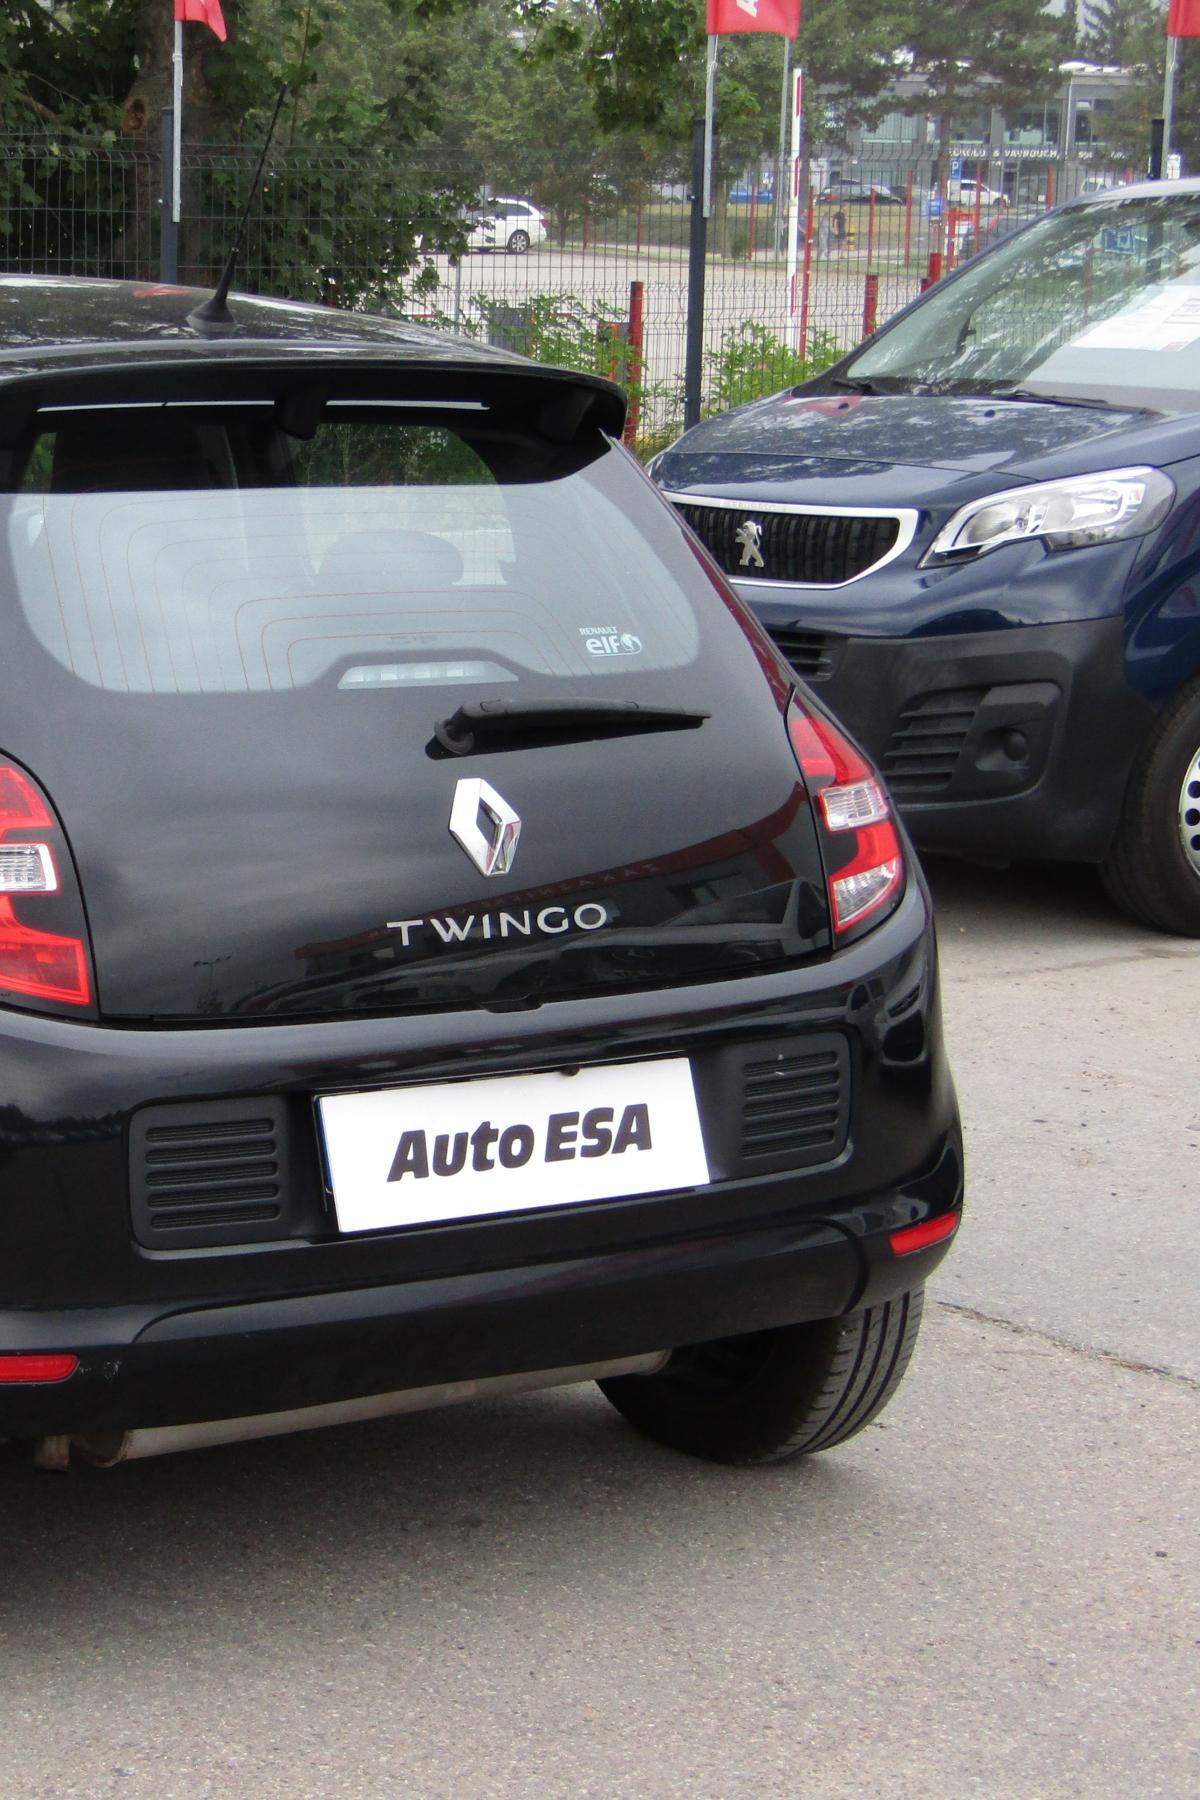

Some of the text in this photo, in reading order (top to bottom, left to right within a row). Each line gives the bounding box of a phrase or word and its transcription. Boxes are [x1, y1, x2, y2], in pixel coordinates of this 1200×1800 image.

[579, 626, 618, 636] RENAULT
[585, 635, 620, 654] elf
[386, 903, 608, 947] TWINGO
[386, 1103, 653, 1183] Auto ESA
